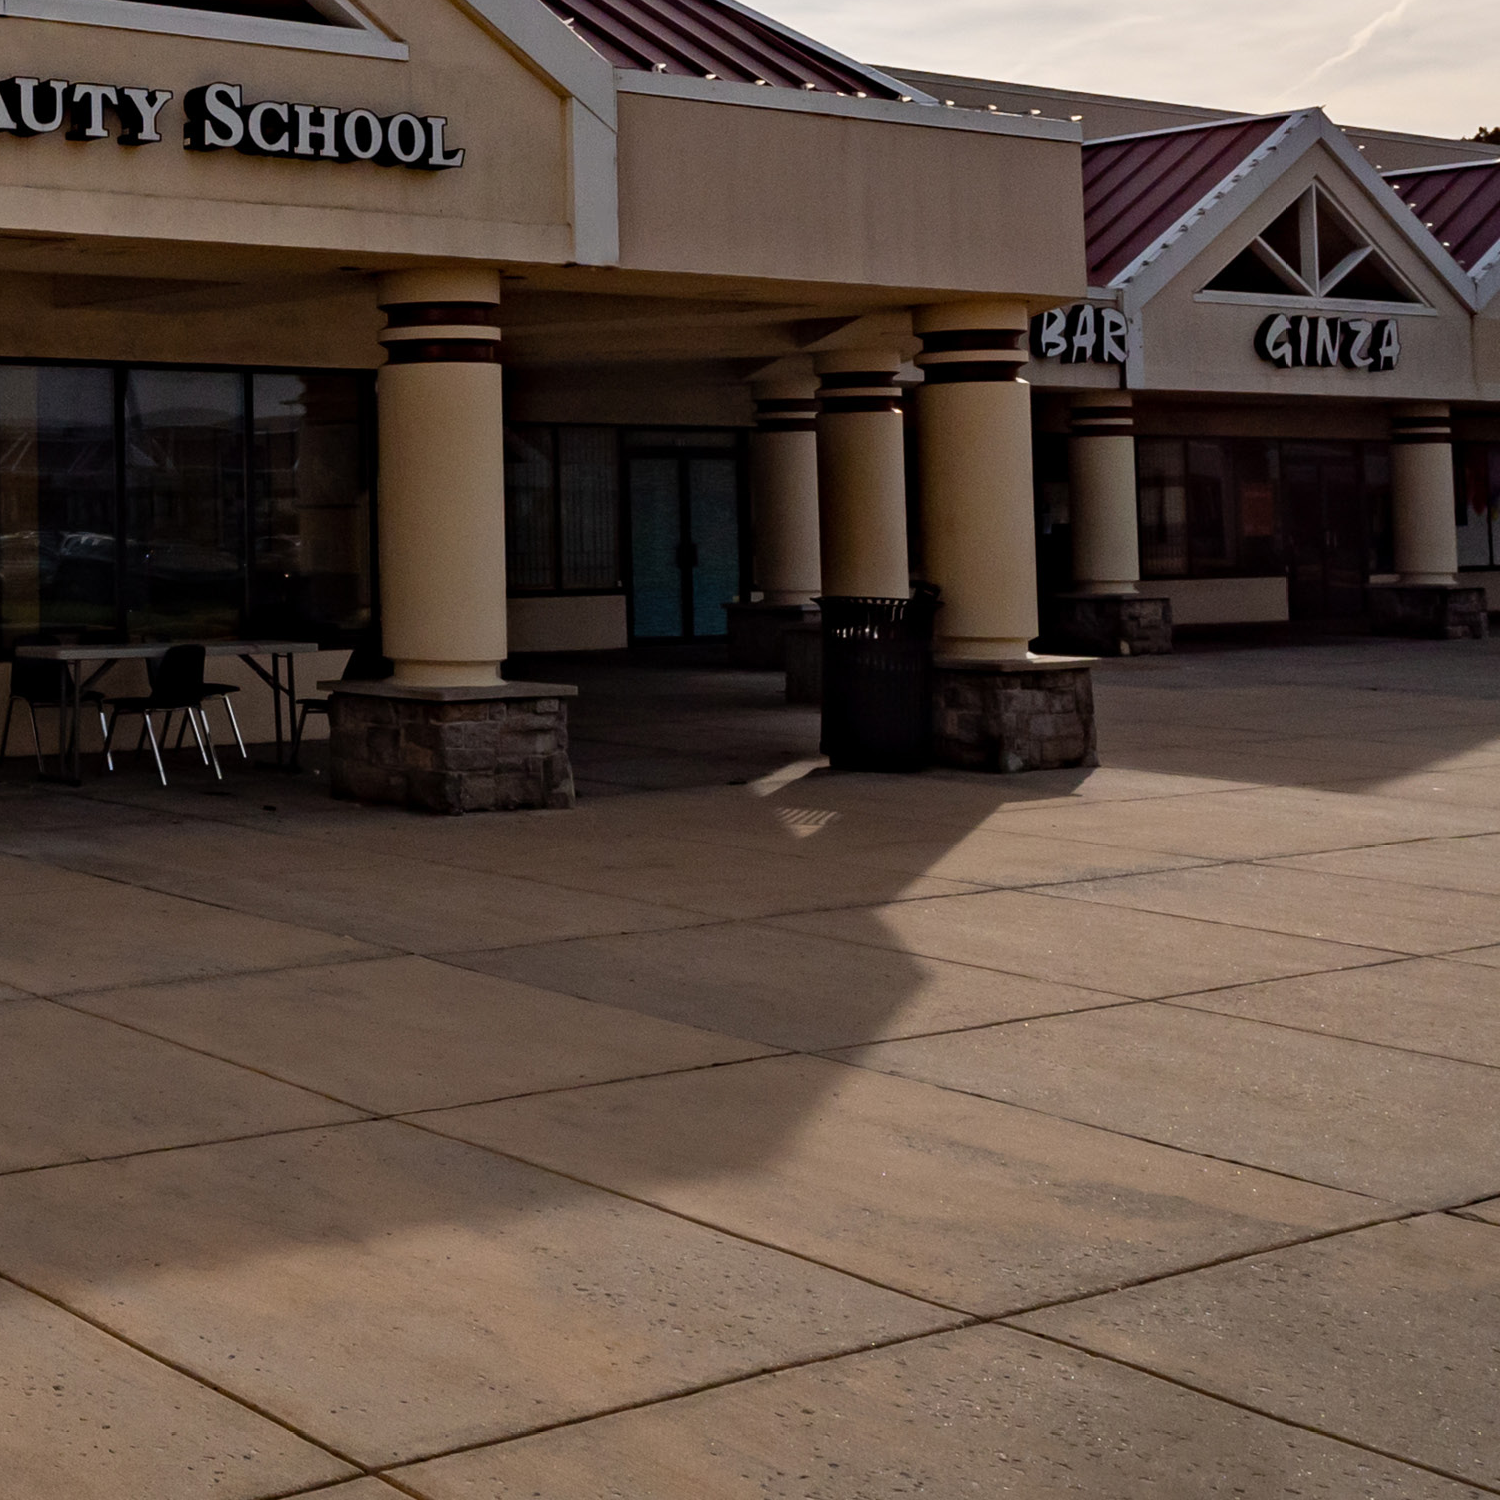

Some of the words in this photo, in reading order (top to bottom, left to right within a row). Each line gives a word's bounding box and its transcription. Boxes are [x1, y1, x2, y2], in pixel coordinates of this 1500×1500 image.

[187, 82, 465, 168] SCHOOL
[1035, 304, 1128, 363] BAR
[1258, 312, 1400, 371] GINZA
